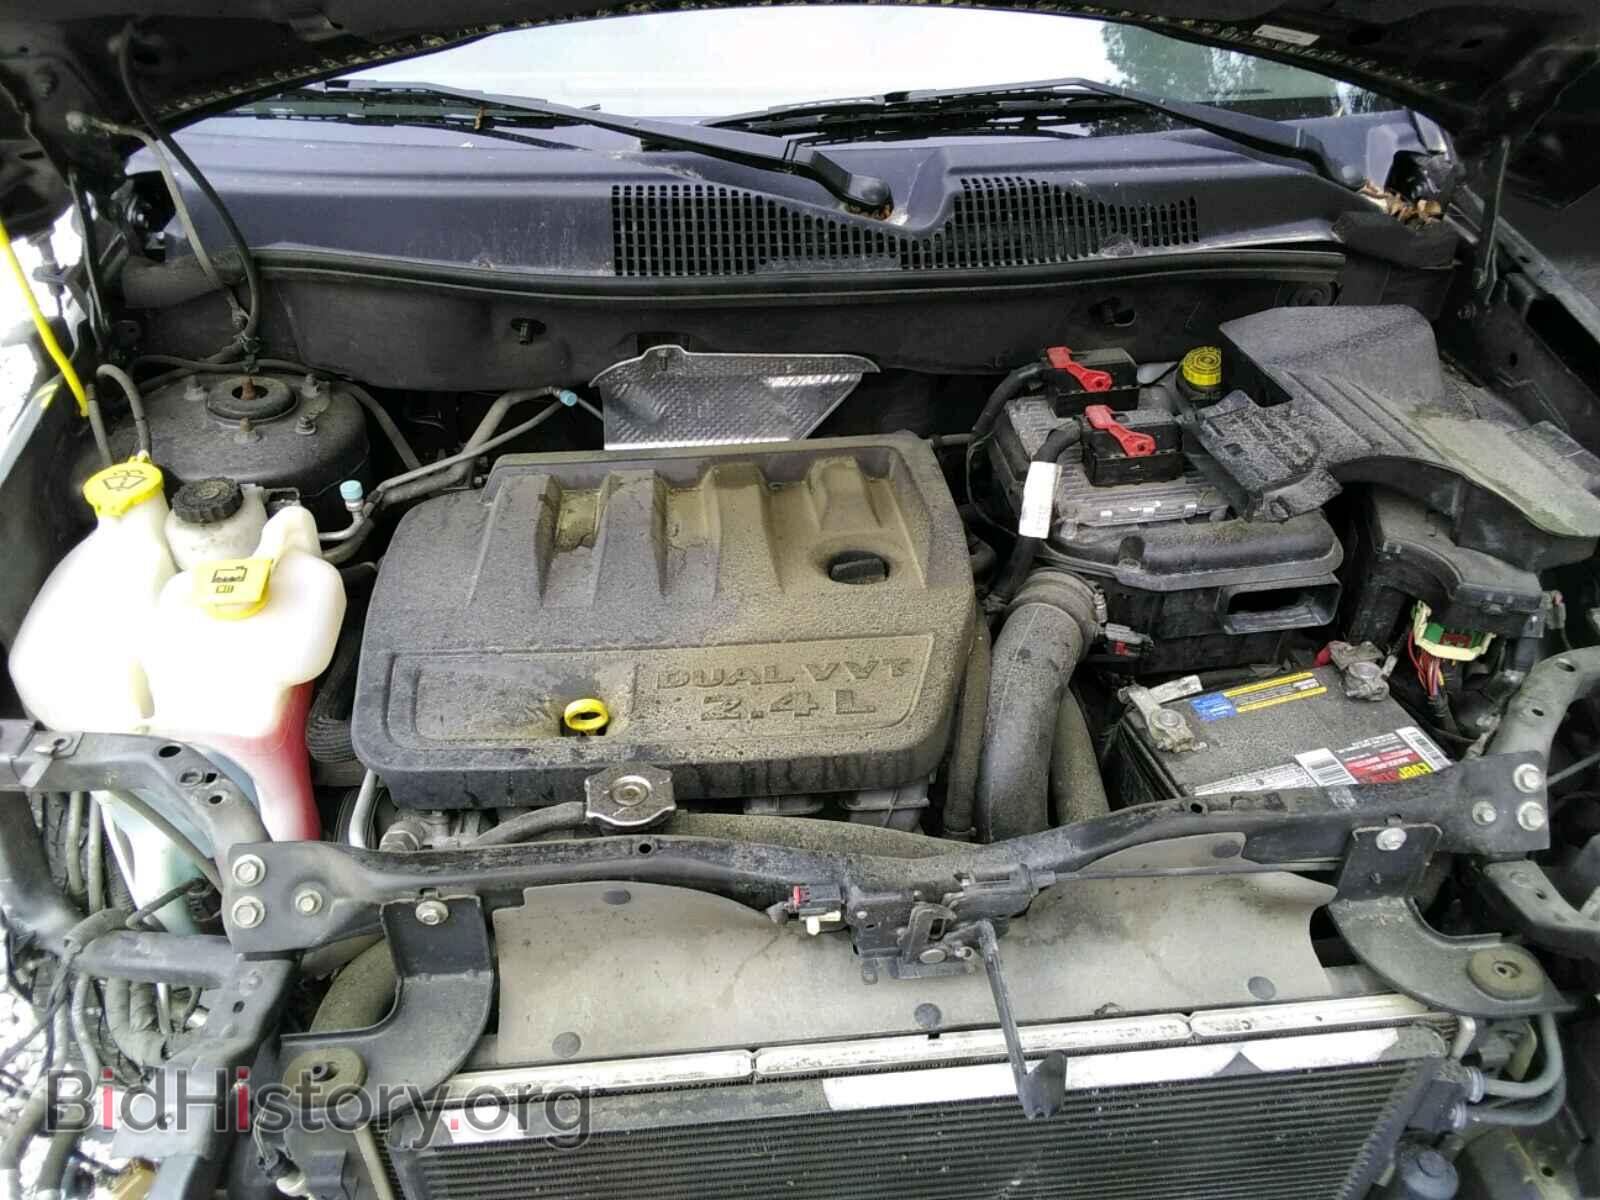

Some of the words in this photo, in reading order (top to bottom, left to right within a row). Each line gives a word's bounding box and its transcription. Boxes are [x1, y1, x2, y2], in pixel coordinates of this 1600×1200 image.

[656, 663, 795, 690] DUAL
[802, 658, 914, 683] VVT
[701, 688, 877, 721] 2.4L
